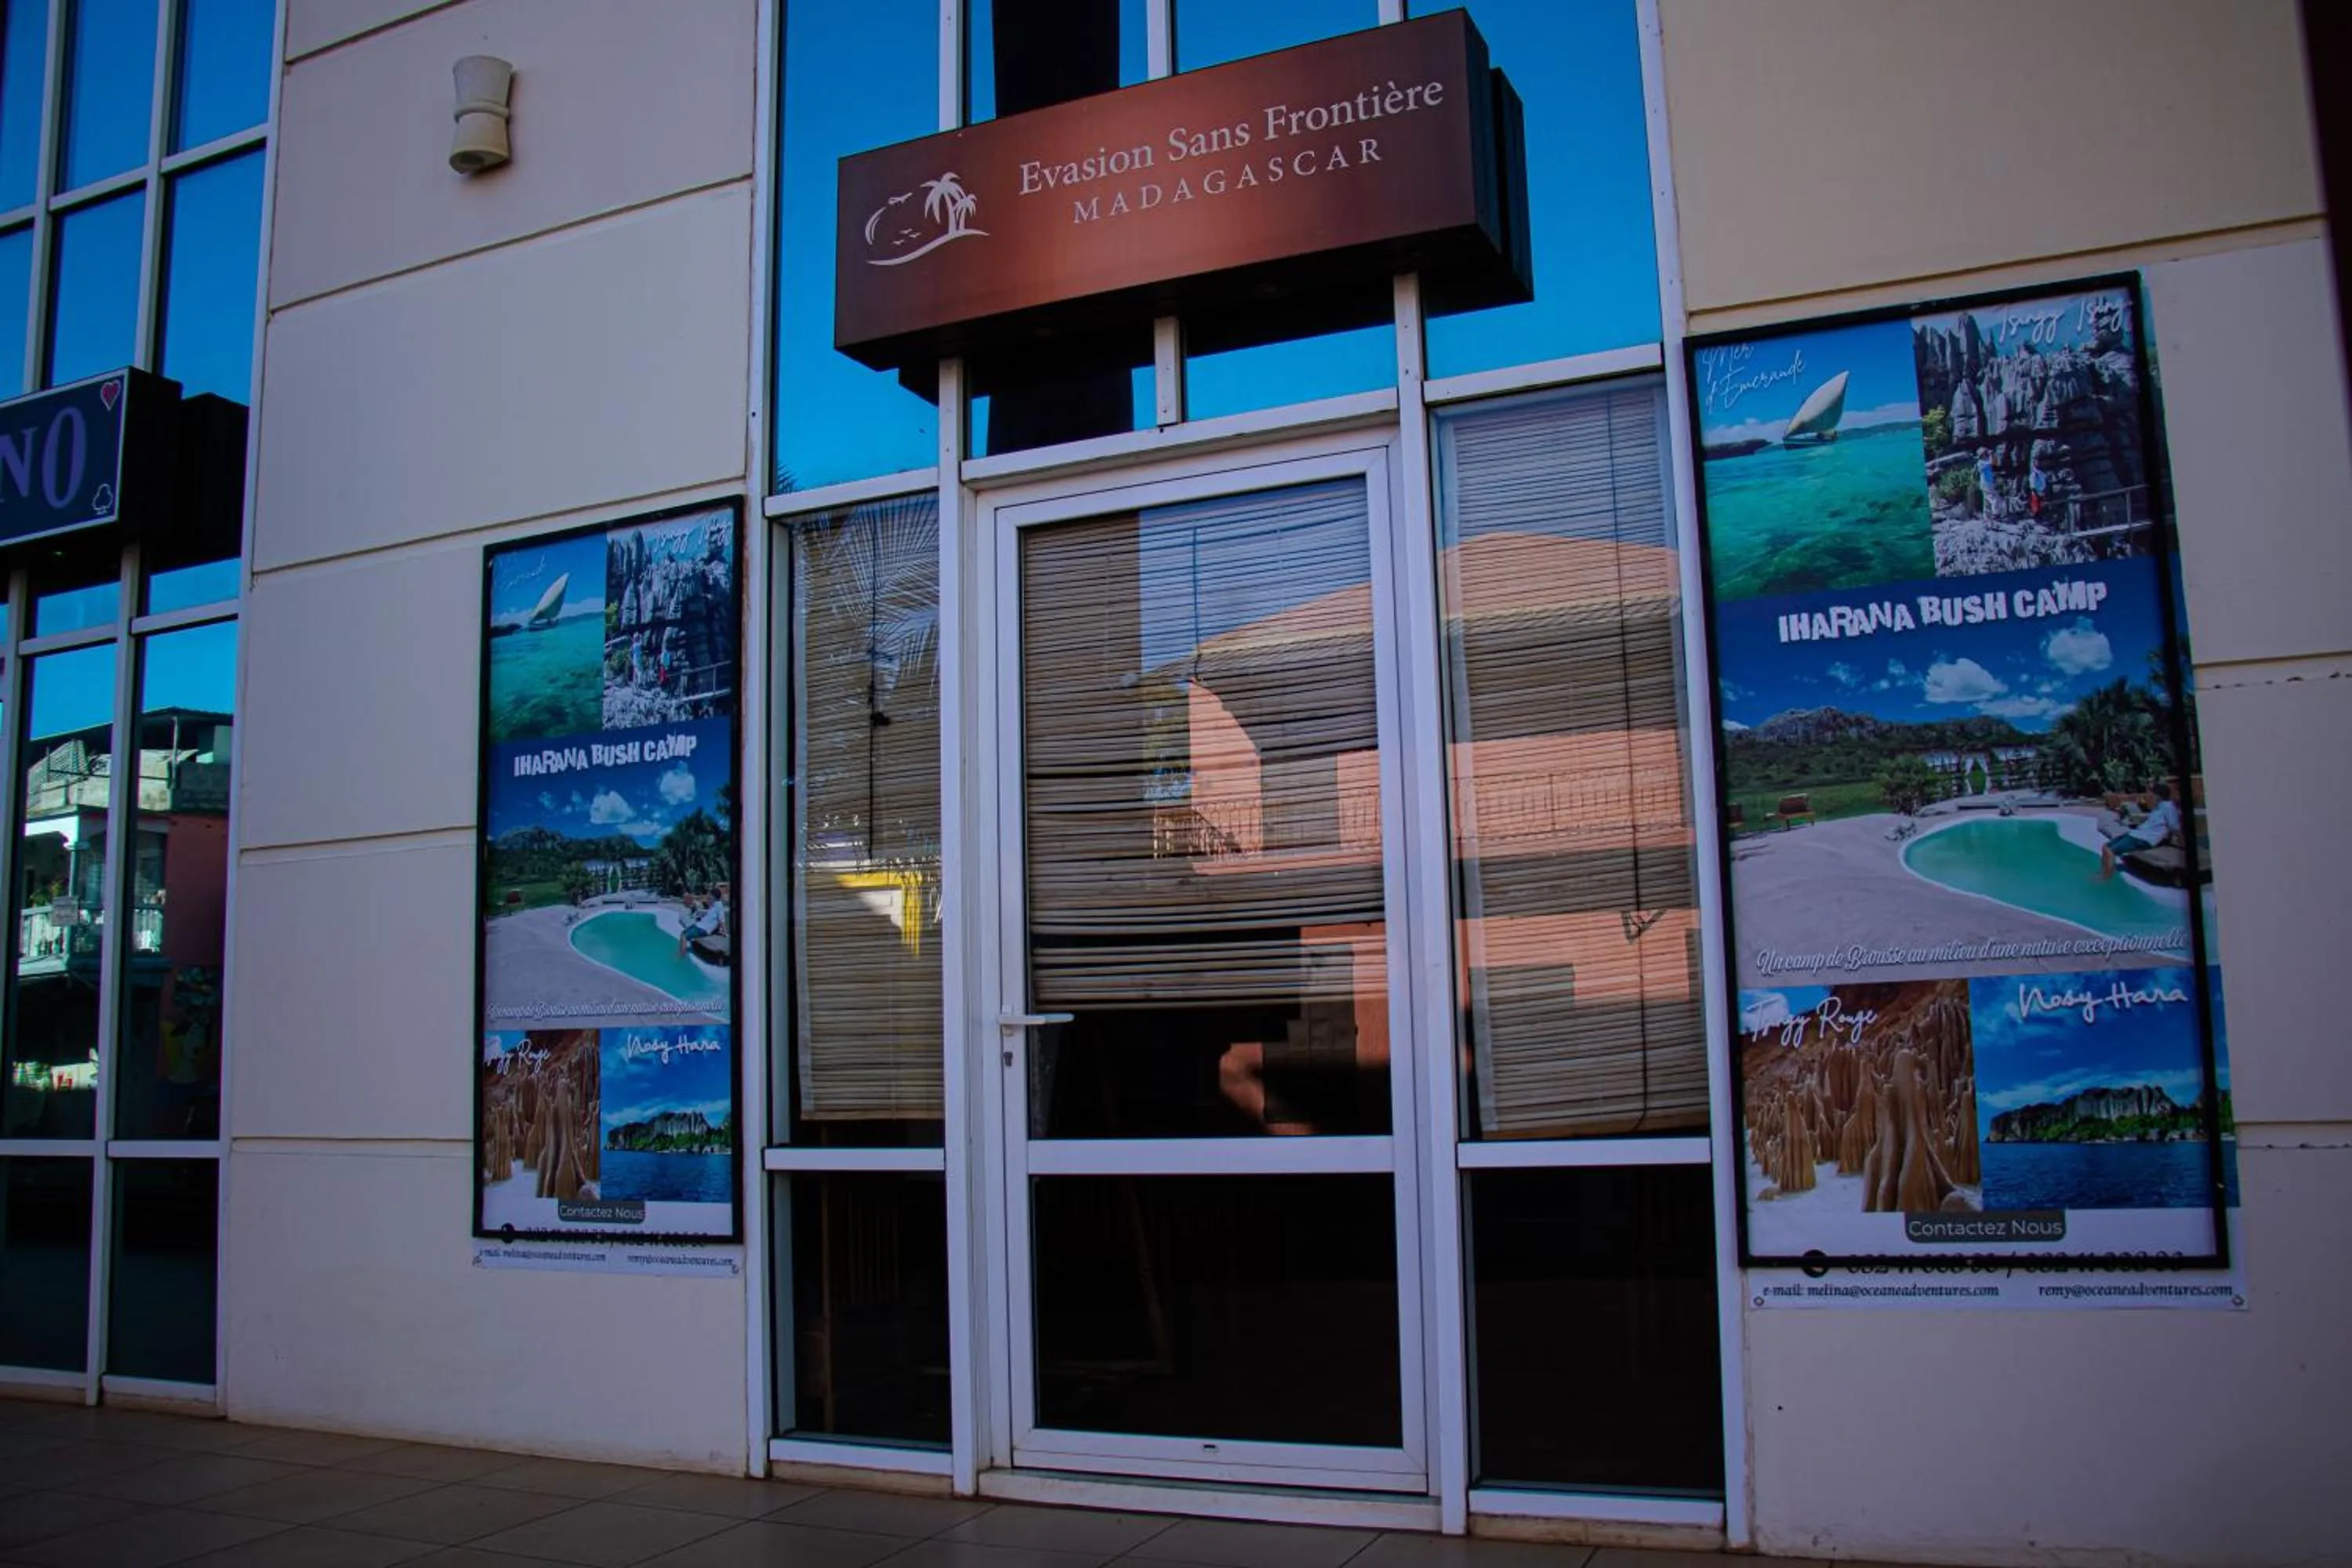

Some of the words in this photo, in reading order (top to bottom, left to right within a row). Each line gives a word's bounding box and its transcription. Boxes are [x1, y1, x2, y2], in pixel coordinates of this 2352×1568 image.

[1019, 145, 1154, 197] Evasion
[1168, 122, 1250, 162] Sans
[1264, 81, 1444, 141] Frontière
[1074, 138, 1382, 224] MADAGASCAR
[1778, 602, 1915, 644] IHARANA
[1917, 590, 2007, 626] BUSH
[2013, 579, 2107, 618] CAMP
[514, 746, 589, 777] IHARANA
[590, 741, 641, 768] BUSH
[643, 732, 697, 762] CAMP
[1756, 947, 1784, 975] Un
[1785, 952, 1825, 975] camp
[1826, 944, 1843, 967] de
[1907, 947, 1927, 963] au
[2020, 938, 2072, 956] nature
[1816, 996, 1878, 1044] Rouge
[2019, 982, 2103, 1023] Nosy
[2105, 981, 2189, 1009] Hara
[1909, 1220, 2006, 1237] Contactez
[2011, 1219, 2063, 1236] Nous
